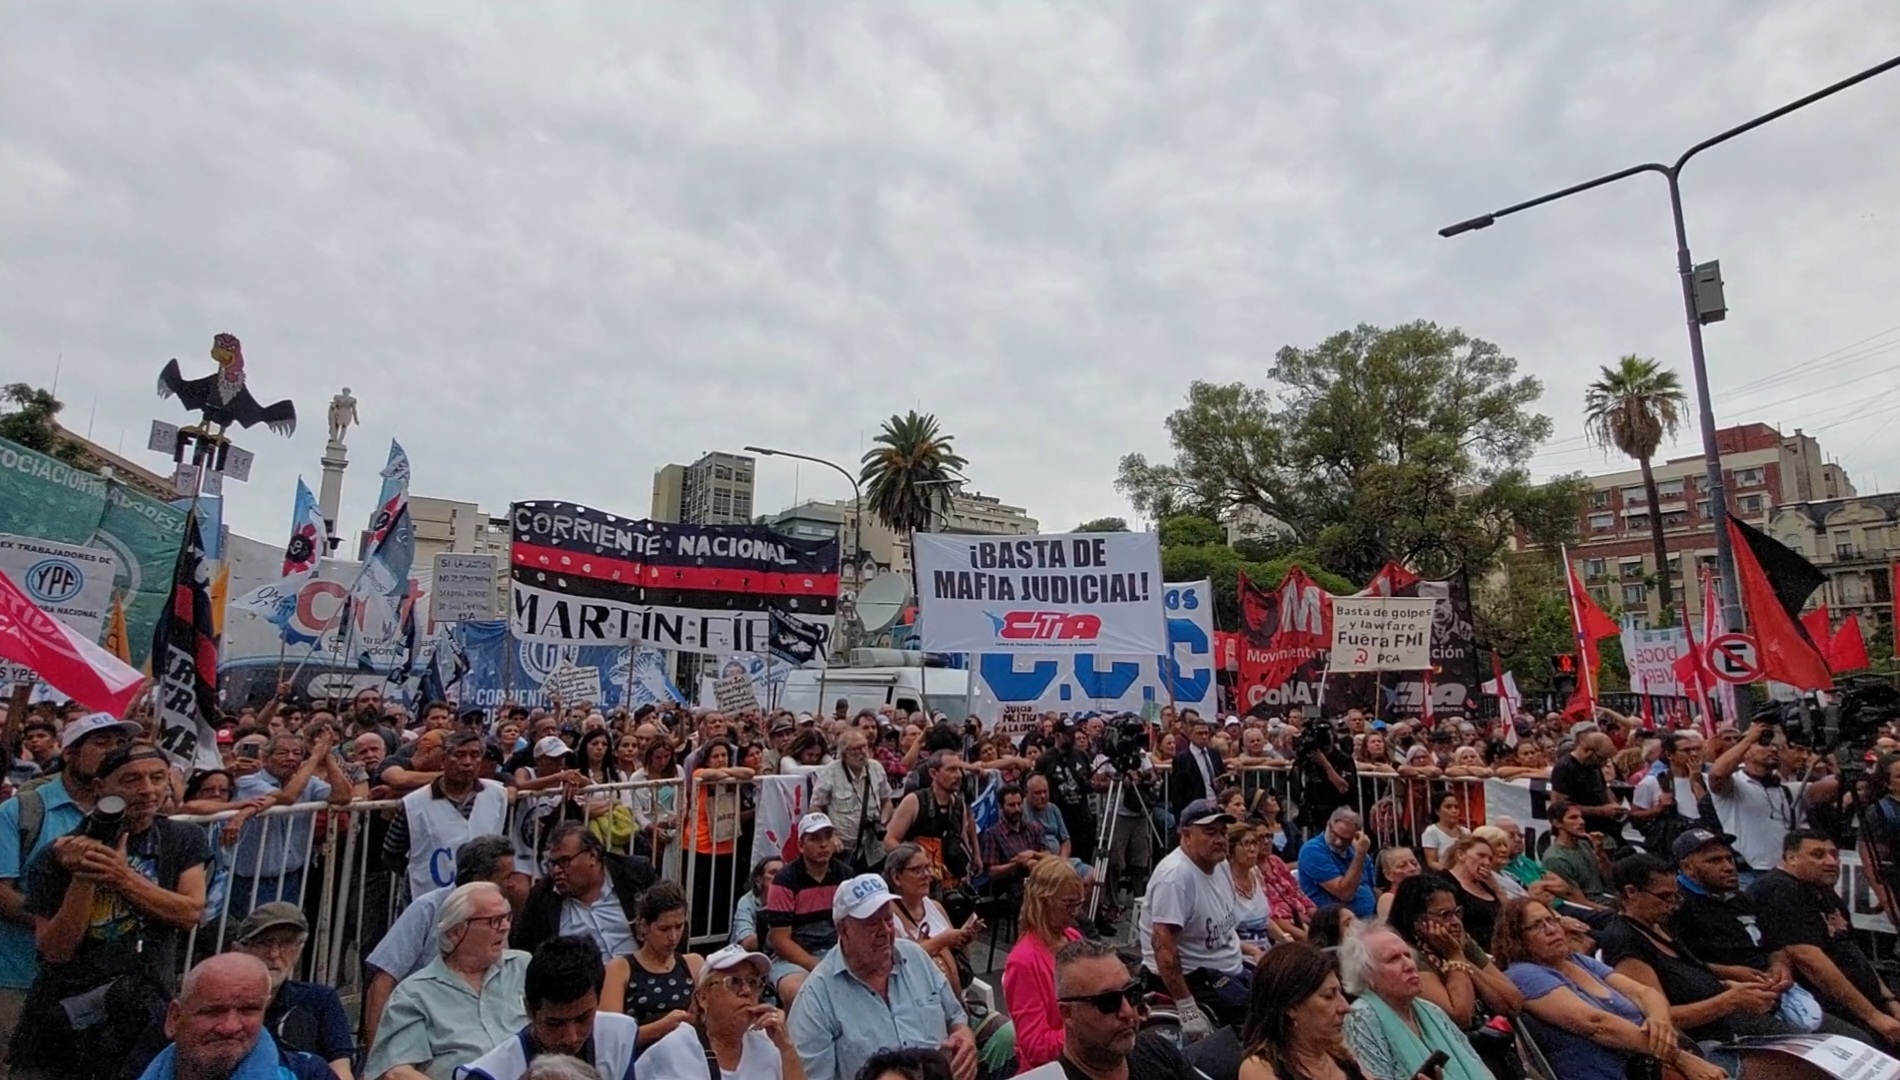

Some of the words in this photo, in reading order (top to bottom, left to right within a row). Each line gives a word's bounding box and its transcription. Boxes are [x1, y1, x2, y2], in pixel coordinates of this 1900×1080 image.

[514, 507, 660, 556] CORRIENTE
[677, 535, 797, 565] NACIONAL
[1, 541, 13, 549] EX
[18, 543, 97, 562] TRABAJADORES
[99, 557, 112, 565] DE
[969, 540, 1067, 569] ¡BASTA
[1073, 539, 1107, 567] DE
[38, 566, 74, 595] YPF
[934, 570, 1016, 600] MAFIA
[1021, 571, 1149, 604] JUDICIAL!
[57, 606, 97, 618] NACIONAL
[514, 587, 683, 646] MARTÍN
[1336, 606, 1371, 616] Basta
[1373, 608, 1388, 617] de
[1391, 608, 1432, 619] golpes
[1000, 610, 1101, 640] CTA
[1349, 621, 1357, 631] y
[1360, 619, 1416, 631] lawfare
[1337, 631, 1390, 648] Fuera
[1394, 631, 1423, 648] FMI
[1377, 654, 1401, 664] PCA
[1722, 643, 1751, 672] E
[1004, 705, 1032, 714] JUICIO
[852, 878, 882, 899] CCC
